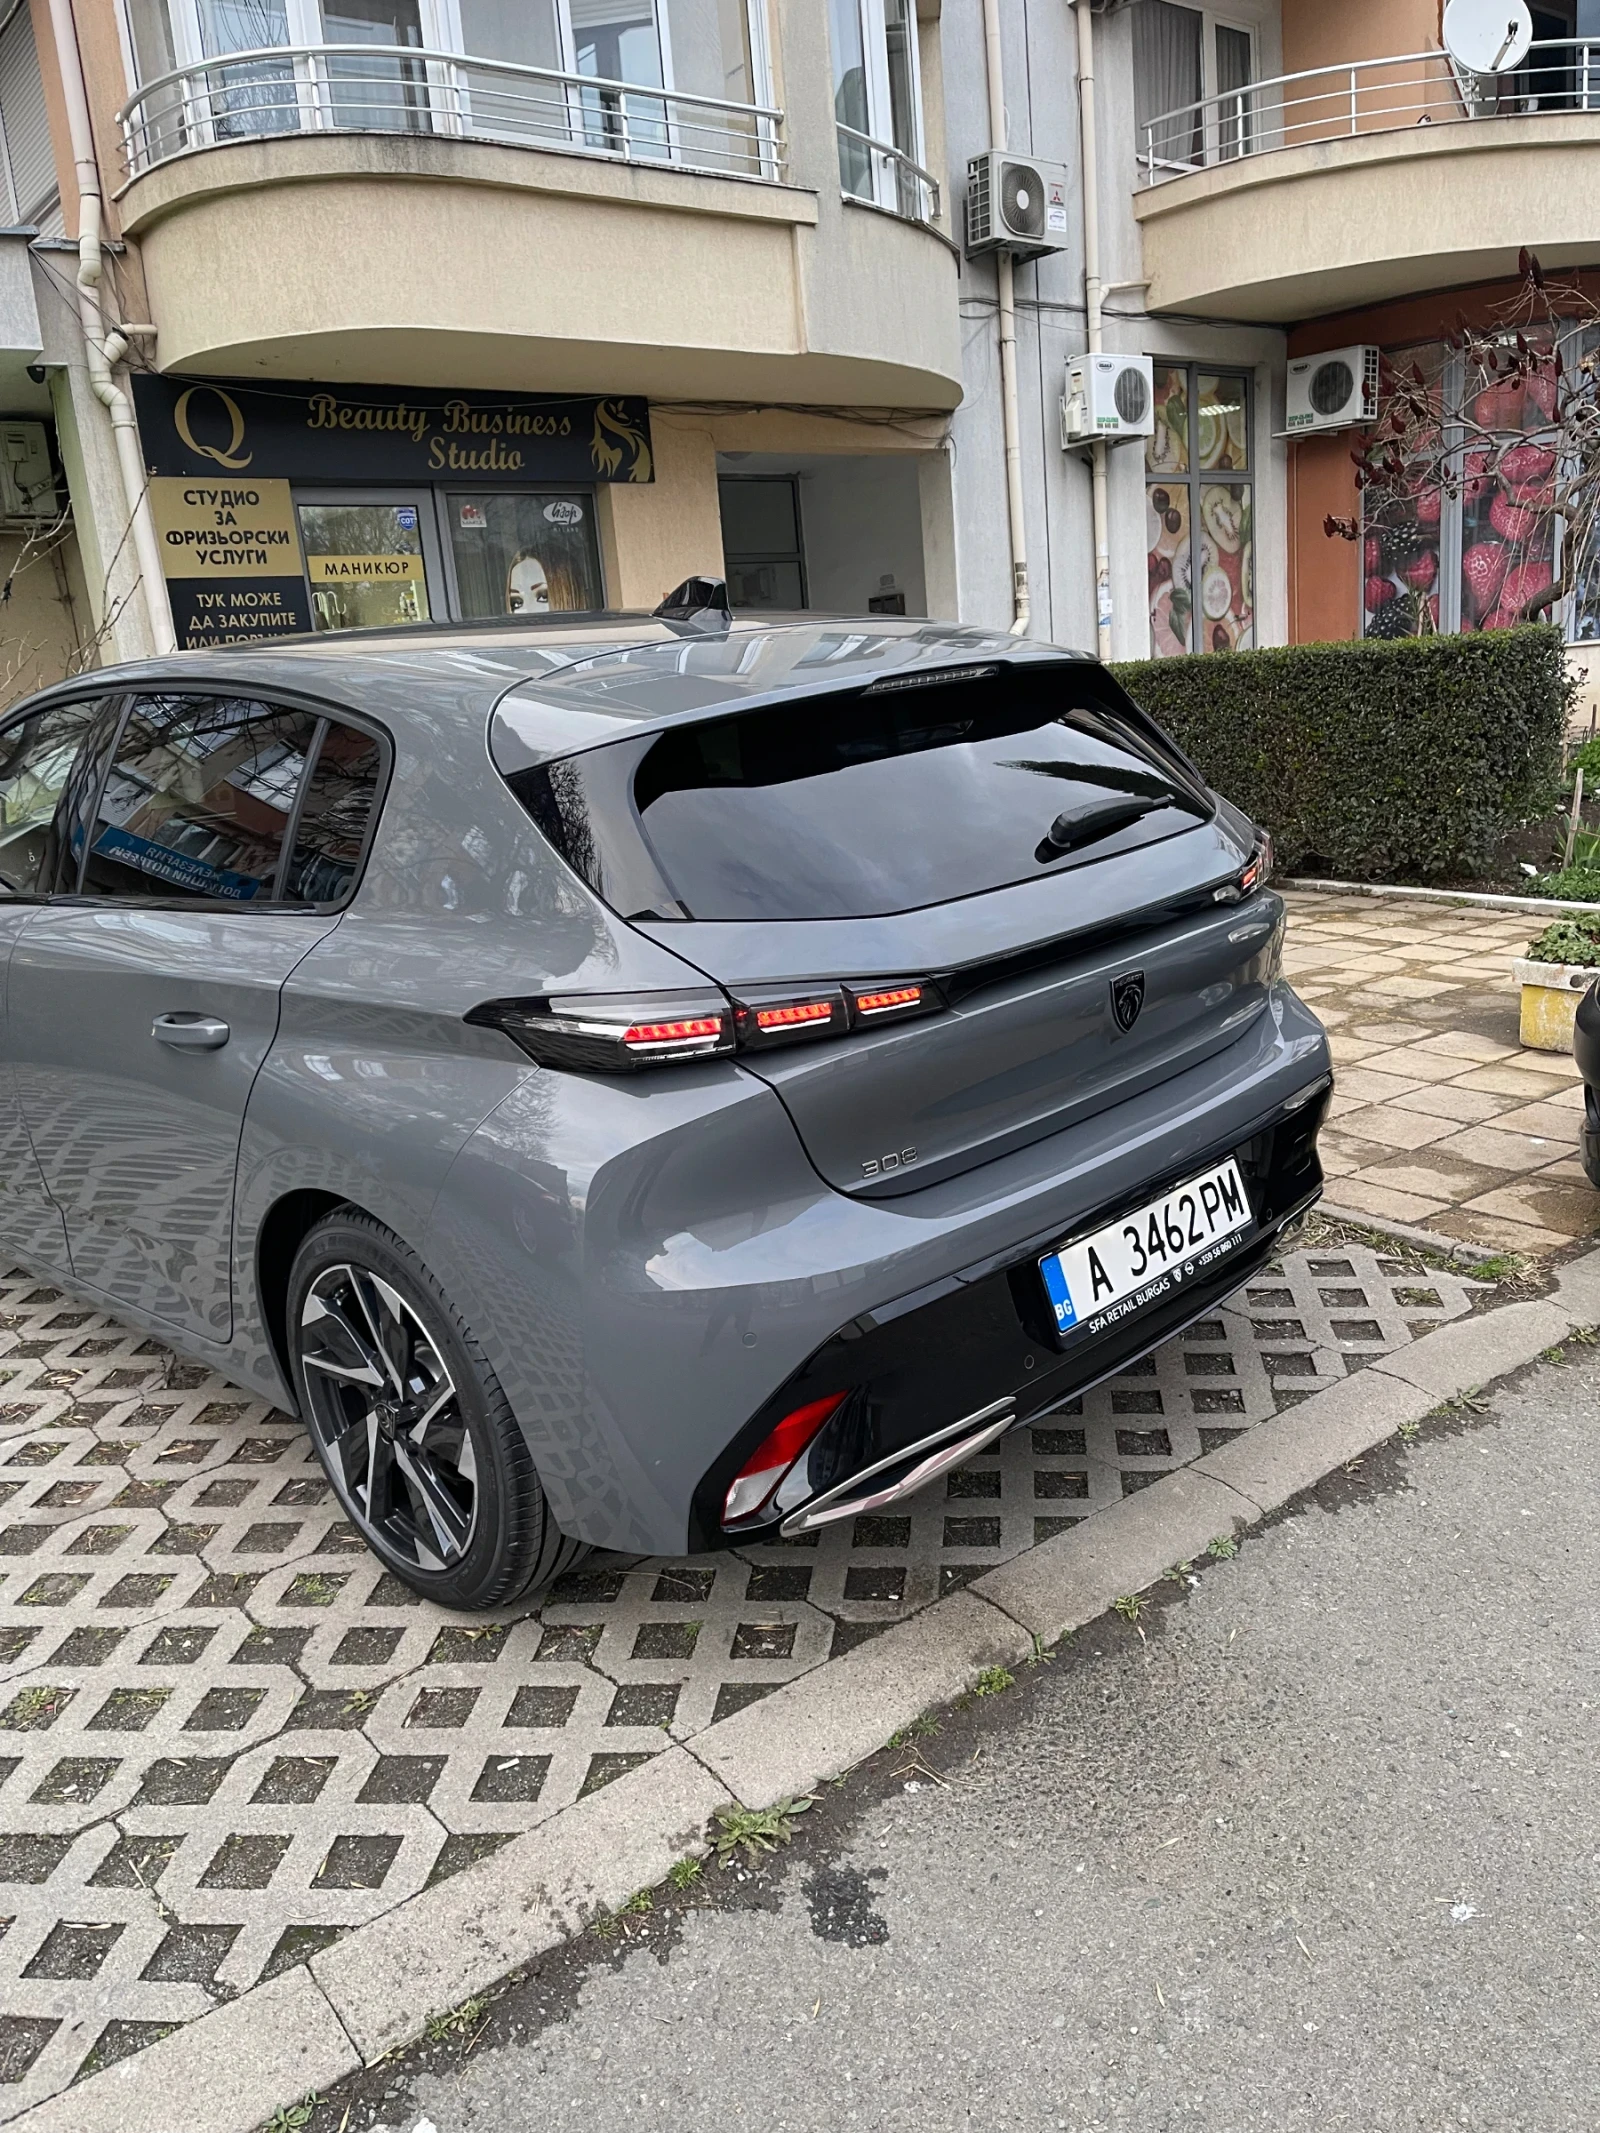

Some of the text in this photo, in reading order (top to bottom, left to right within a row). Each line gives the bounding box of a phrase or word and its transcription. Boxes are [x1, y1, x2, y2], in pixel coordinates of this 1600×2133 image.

[307, 393, 572, 442] Beauty Business
[174, 386, 253, 469] Q
[428, 436, 525, 470] Studio
[183, 490, 260, 508] СТУДИО
[214, 511, 237, 525] ЗА
[165, 530, 290, 545] ФРИЗЬОРСКИ
[196, 550, 267, 565] УСЛУГИ
[324, 562, 409, 575] МАНИКЮР
[196, 592, 282, 608] ТУК МОЖЕ
[188, 612, 297, 631] ДА ЗАКУПИТЕ
[1114, 973, 1143, 989] PEUGEOT
[861, 1146, 918, 1179] 308
[1087, 1245, 1114, 1302] A
[1054, 1299, 1073, 1321] BG
[1089, 1277, 1171, 1334] SFA RETAIL BURGAS
